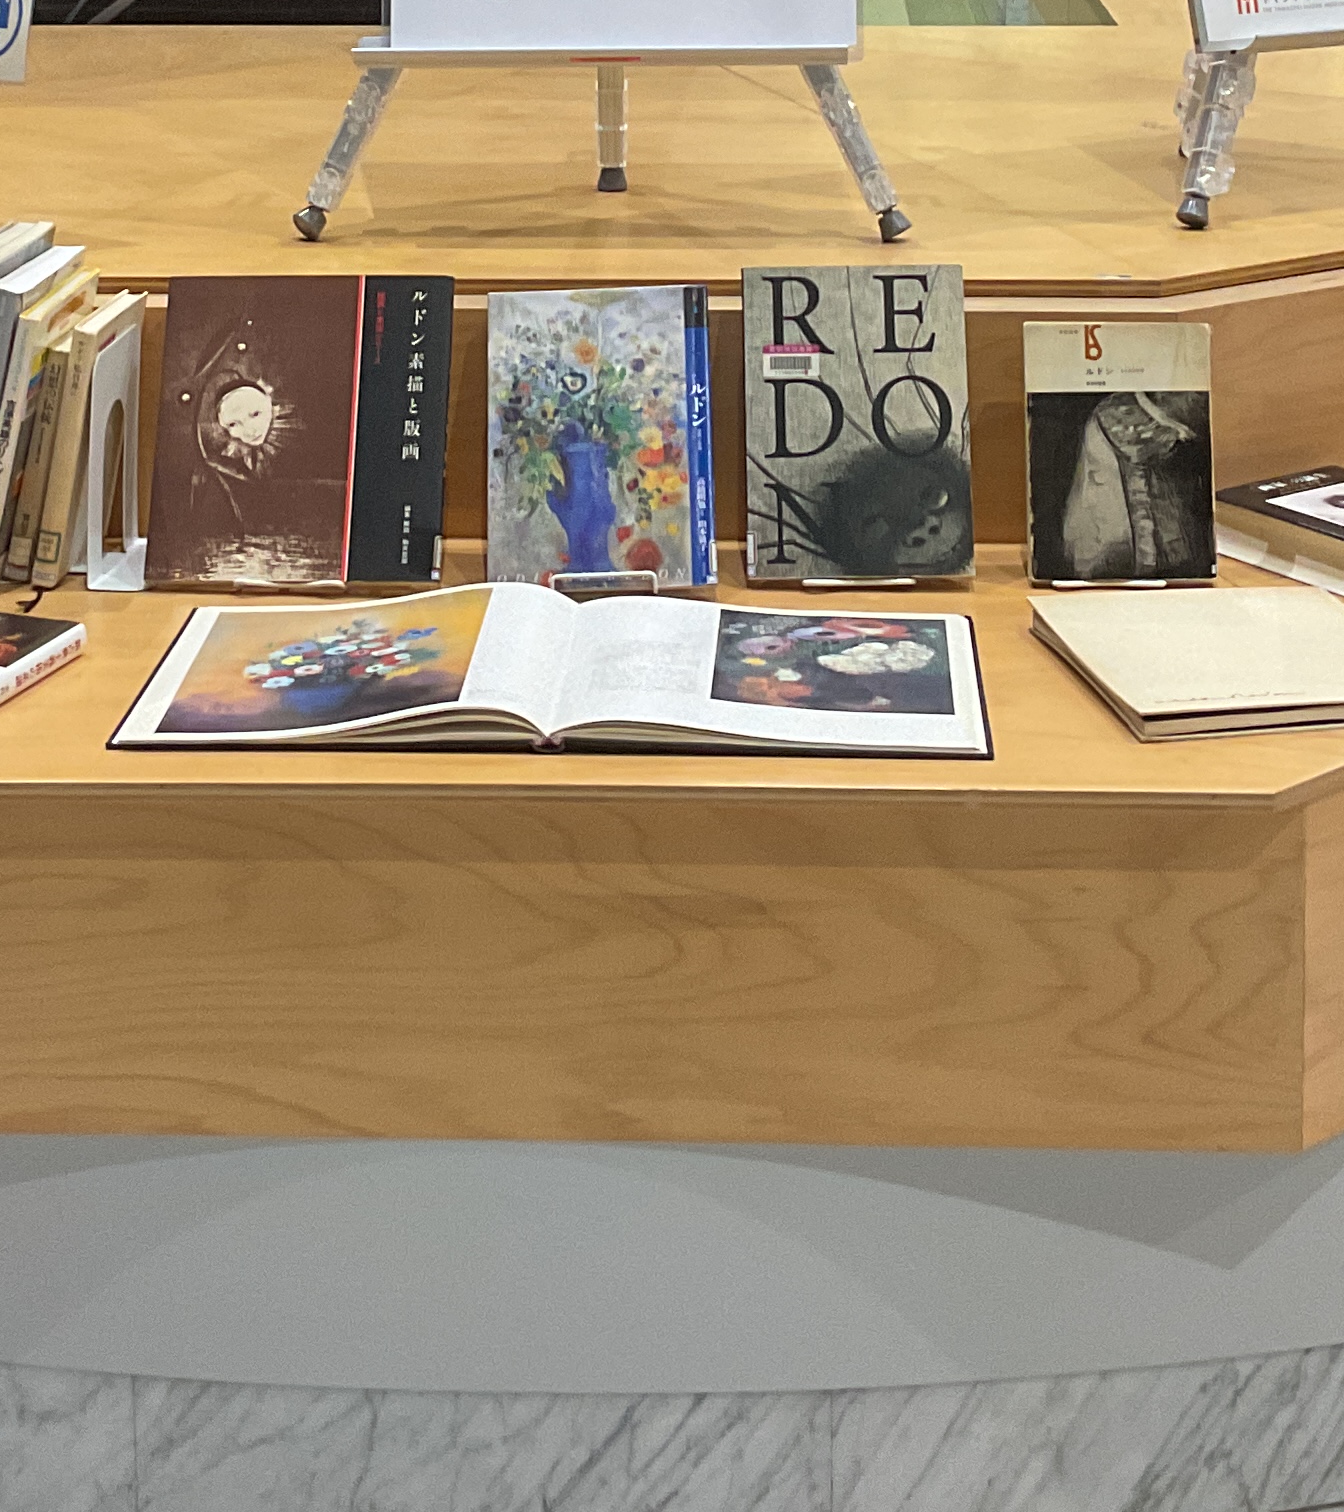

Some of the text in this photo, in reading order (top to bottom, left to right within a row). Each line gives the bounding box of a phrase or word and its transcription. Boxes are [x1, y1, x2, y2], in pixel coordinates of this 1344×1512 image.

[401, 289, 427, 461] ルドン素描と版画
[691, 382, 707, 427] ルドン
